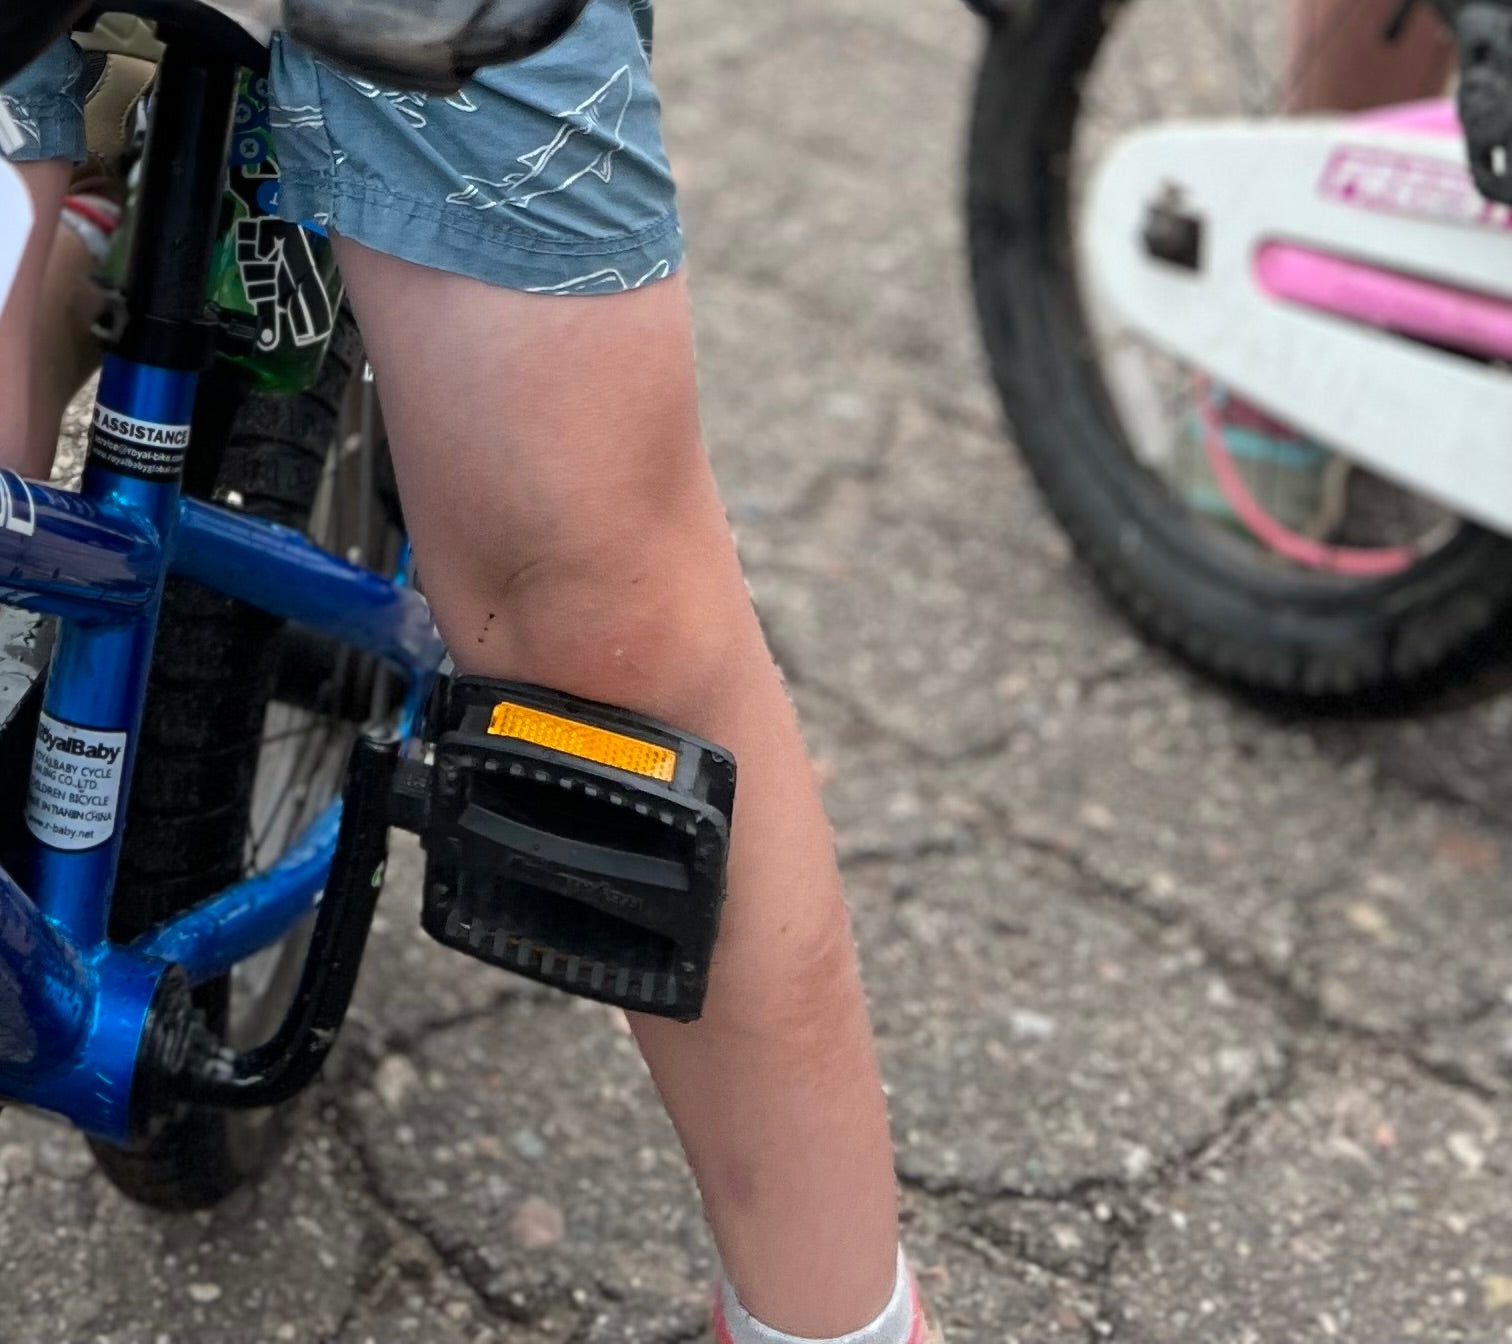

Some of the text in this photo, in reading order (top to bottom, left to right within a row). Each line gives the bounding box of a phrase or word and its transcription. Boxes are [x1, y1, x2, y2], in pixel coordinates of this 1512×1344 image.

[81, 767, 113, 779] CYCLE
[68, 792, 109, 807] BICYCLE
[85, 811, 113, 822] CHINA
